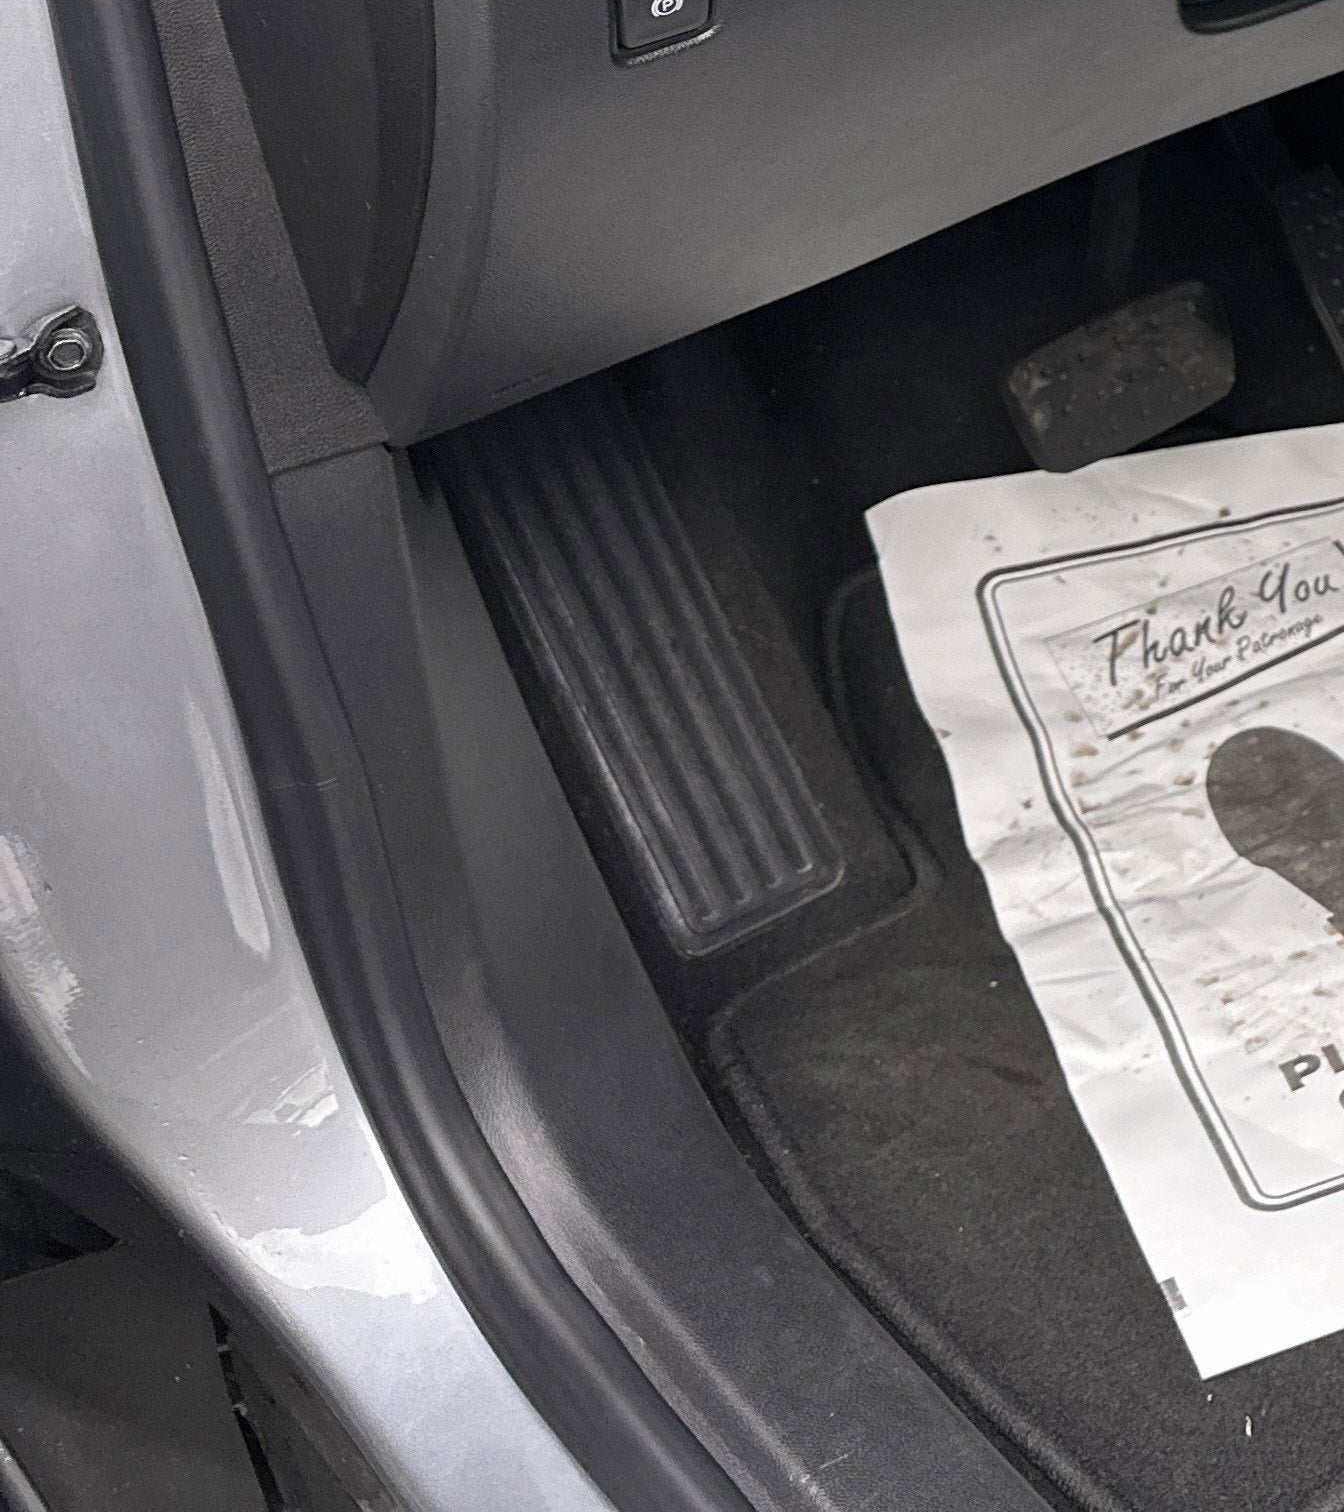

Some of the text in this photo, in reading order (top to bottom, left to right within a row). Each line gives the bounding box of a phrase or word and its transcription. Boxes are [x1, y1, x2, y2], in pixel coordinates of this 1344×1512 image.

[1093, 562, 1340, 687] Thank You
[1153, 614, 1324, 700] For Your Patronage
